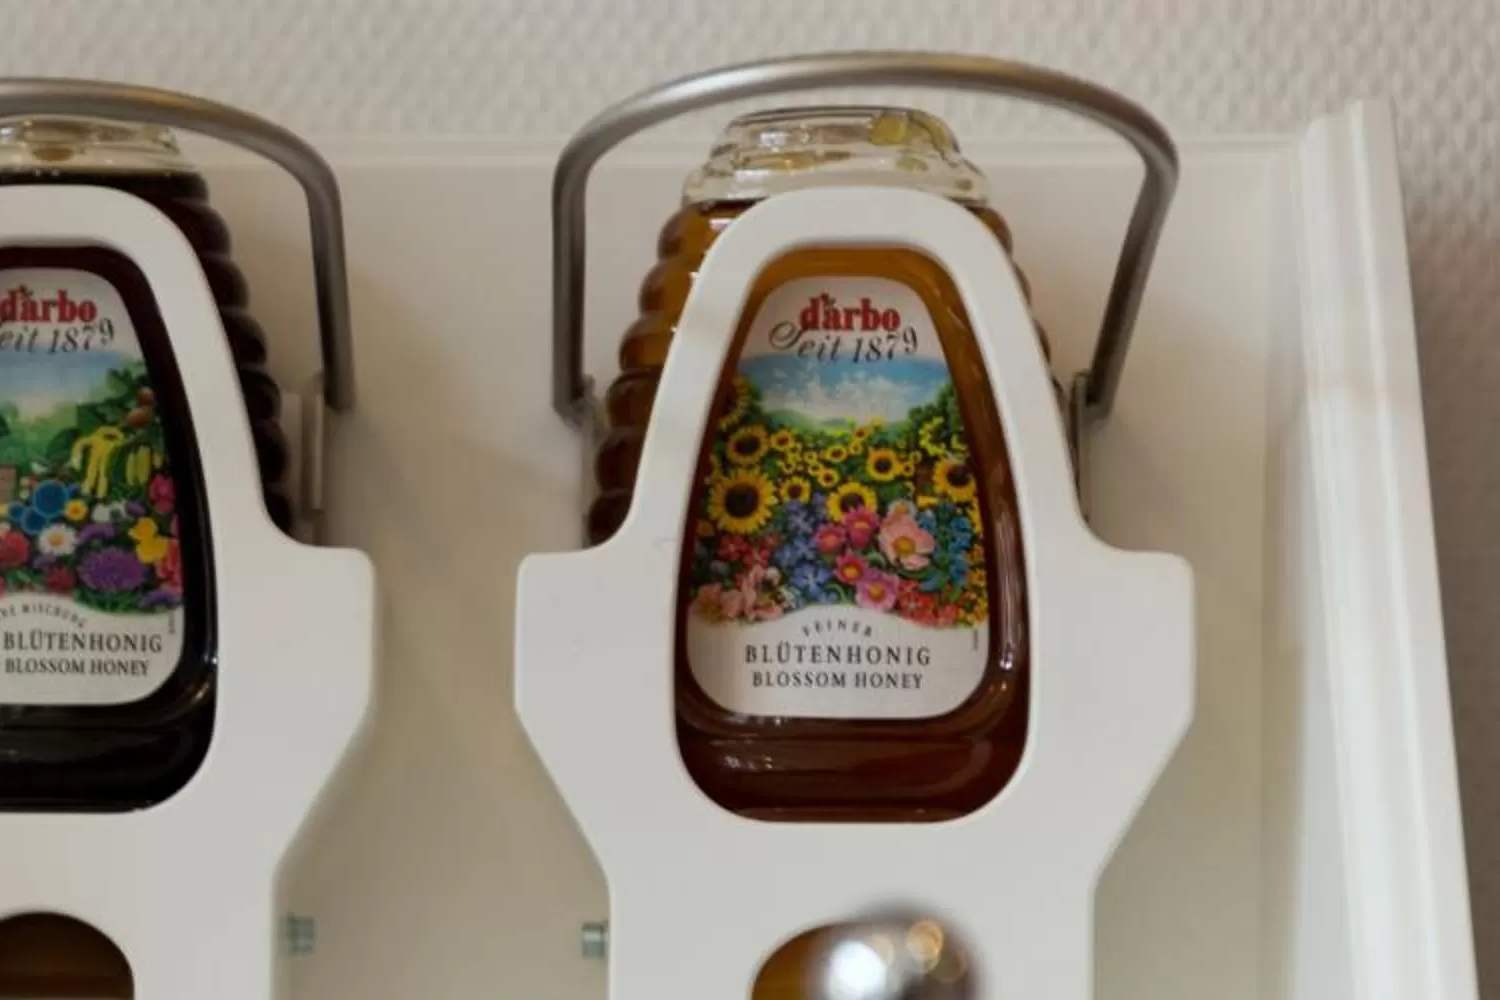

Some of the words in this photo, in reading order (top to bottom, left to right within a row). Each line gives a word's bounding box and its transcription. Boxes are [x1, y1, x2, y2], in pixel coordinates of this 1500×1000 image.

[46, 317, 116, 355] 1879
[769, 320, 841, 363] Seit
[851, 326, 918, 364] 1879
[3, 627, 164, 653] BLÜTENHONIG
[802, 618, 874, 638] FEINER
[745, 640, 932, 667] BLÜTENHONIG
[5, 657, 86, 675] BLOSSOM
[90, 658, 150, 677] HONEY
[752, 670, 847, 689] BLOSSOM
[854, 671, 924, 690] HONEY
